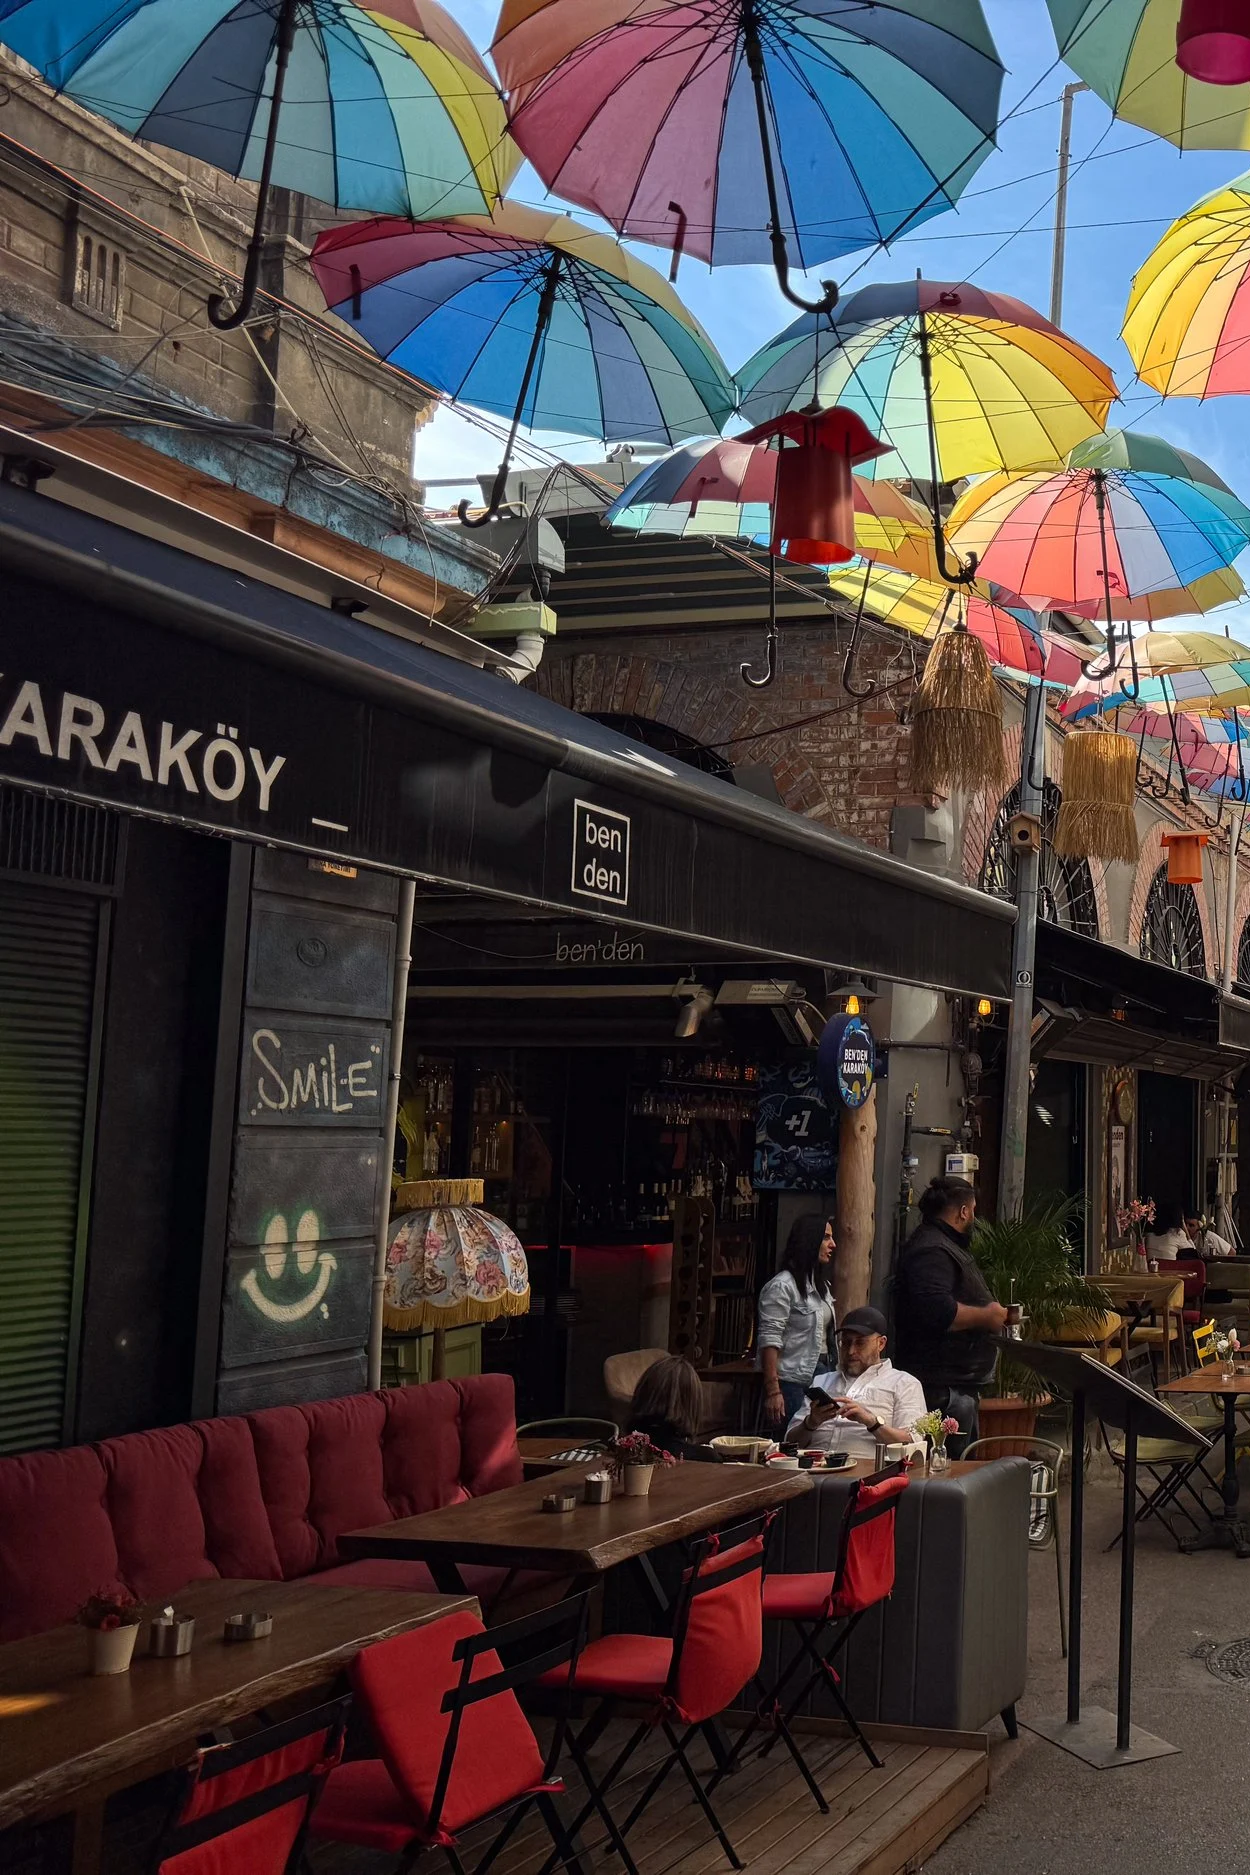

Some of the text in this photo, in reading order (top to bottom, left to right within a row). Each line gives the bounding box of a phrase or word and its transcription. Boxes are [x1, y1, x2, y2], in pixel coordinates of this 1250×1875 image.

[0, 673, 287, 811] ARAKÖY
[585, 813, 622, 853] ben
[583, 856, 621, 895] den
[556, 931, 644, 962] ben'den
